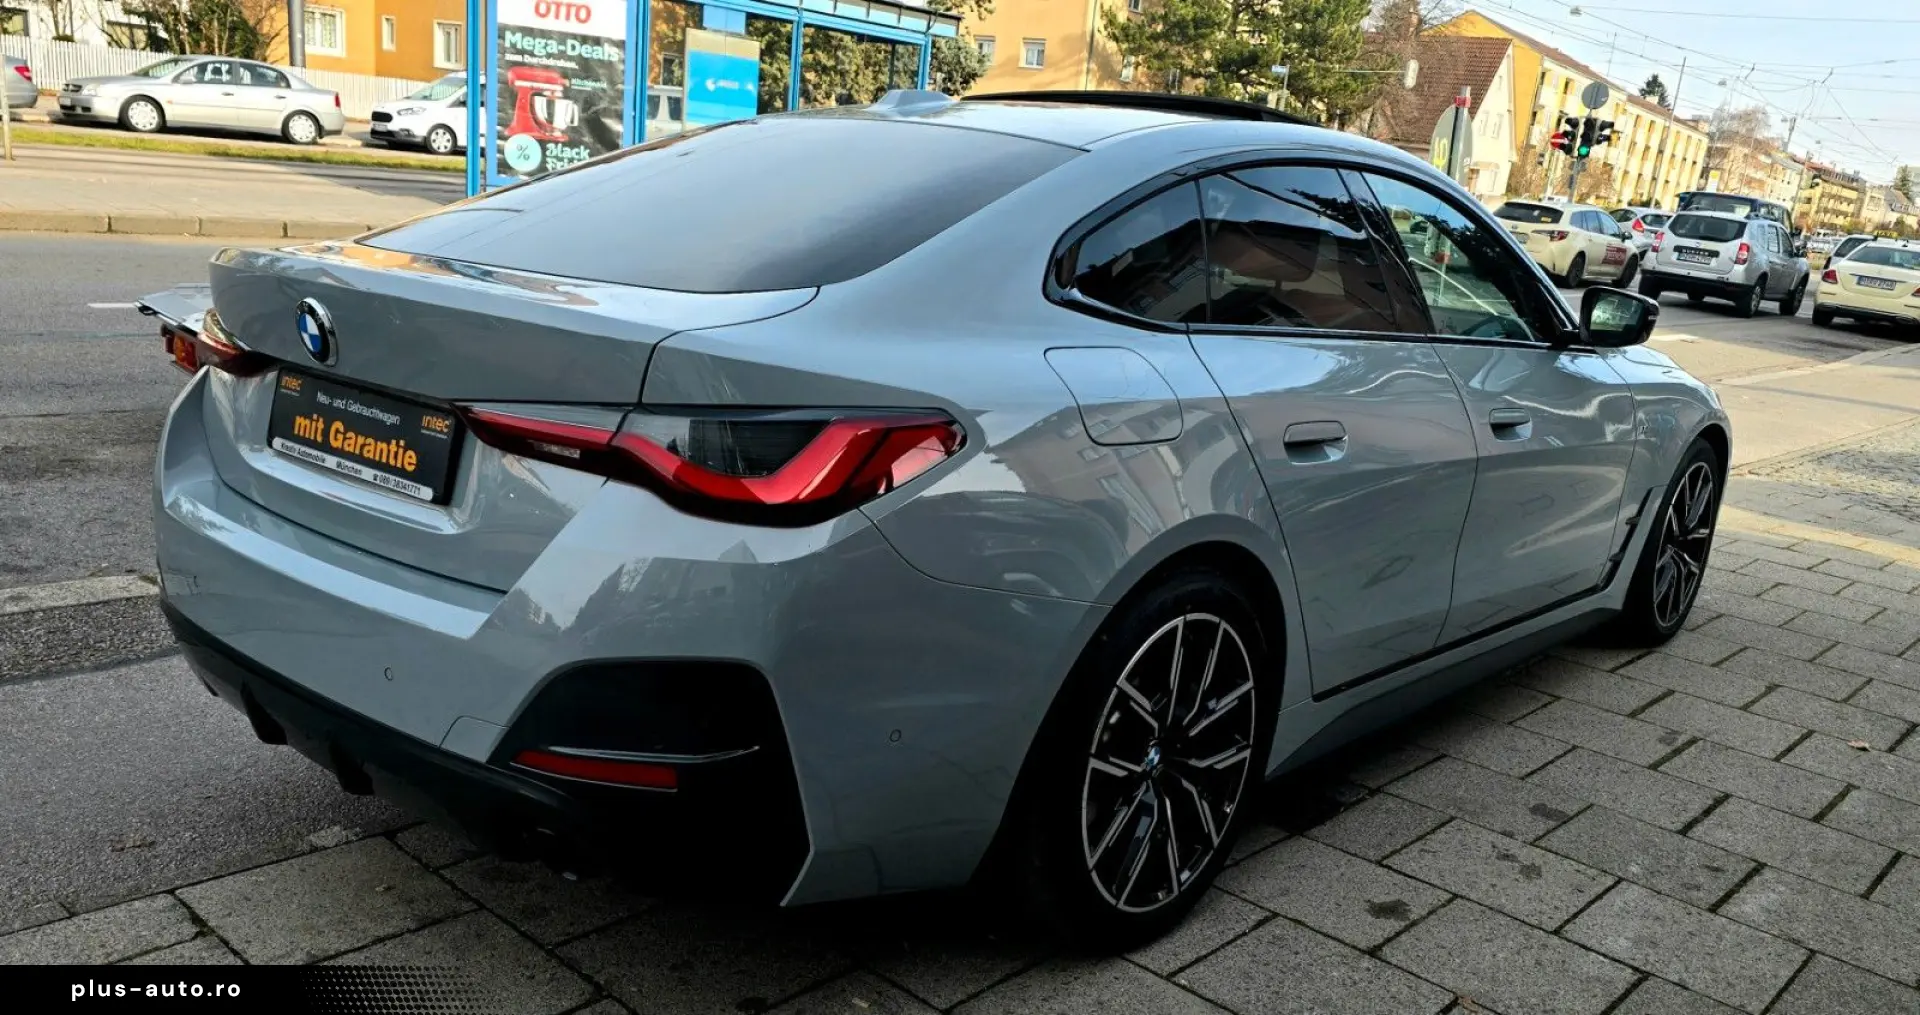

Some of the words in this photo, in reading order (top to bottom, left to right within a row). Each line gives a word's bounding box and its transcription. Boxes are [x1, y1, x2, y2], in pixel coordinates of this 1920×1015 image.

[534, 0, 591, 24] OTTO
[504, 31, 619, 62] Mega-Deals
[546, 143, 590, 161] Black
[316, 390, 332, 404] Neu-
[333, 399, 346, 409] und
[346, 399, 401, 426] Gebrauchtwagen
[294, 413, 324, 443] mit
[330, 420, 417, 471] Garantie
[336, 460, 363, 476] München
